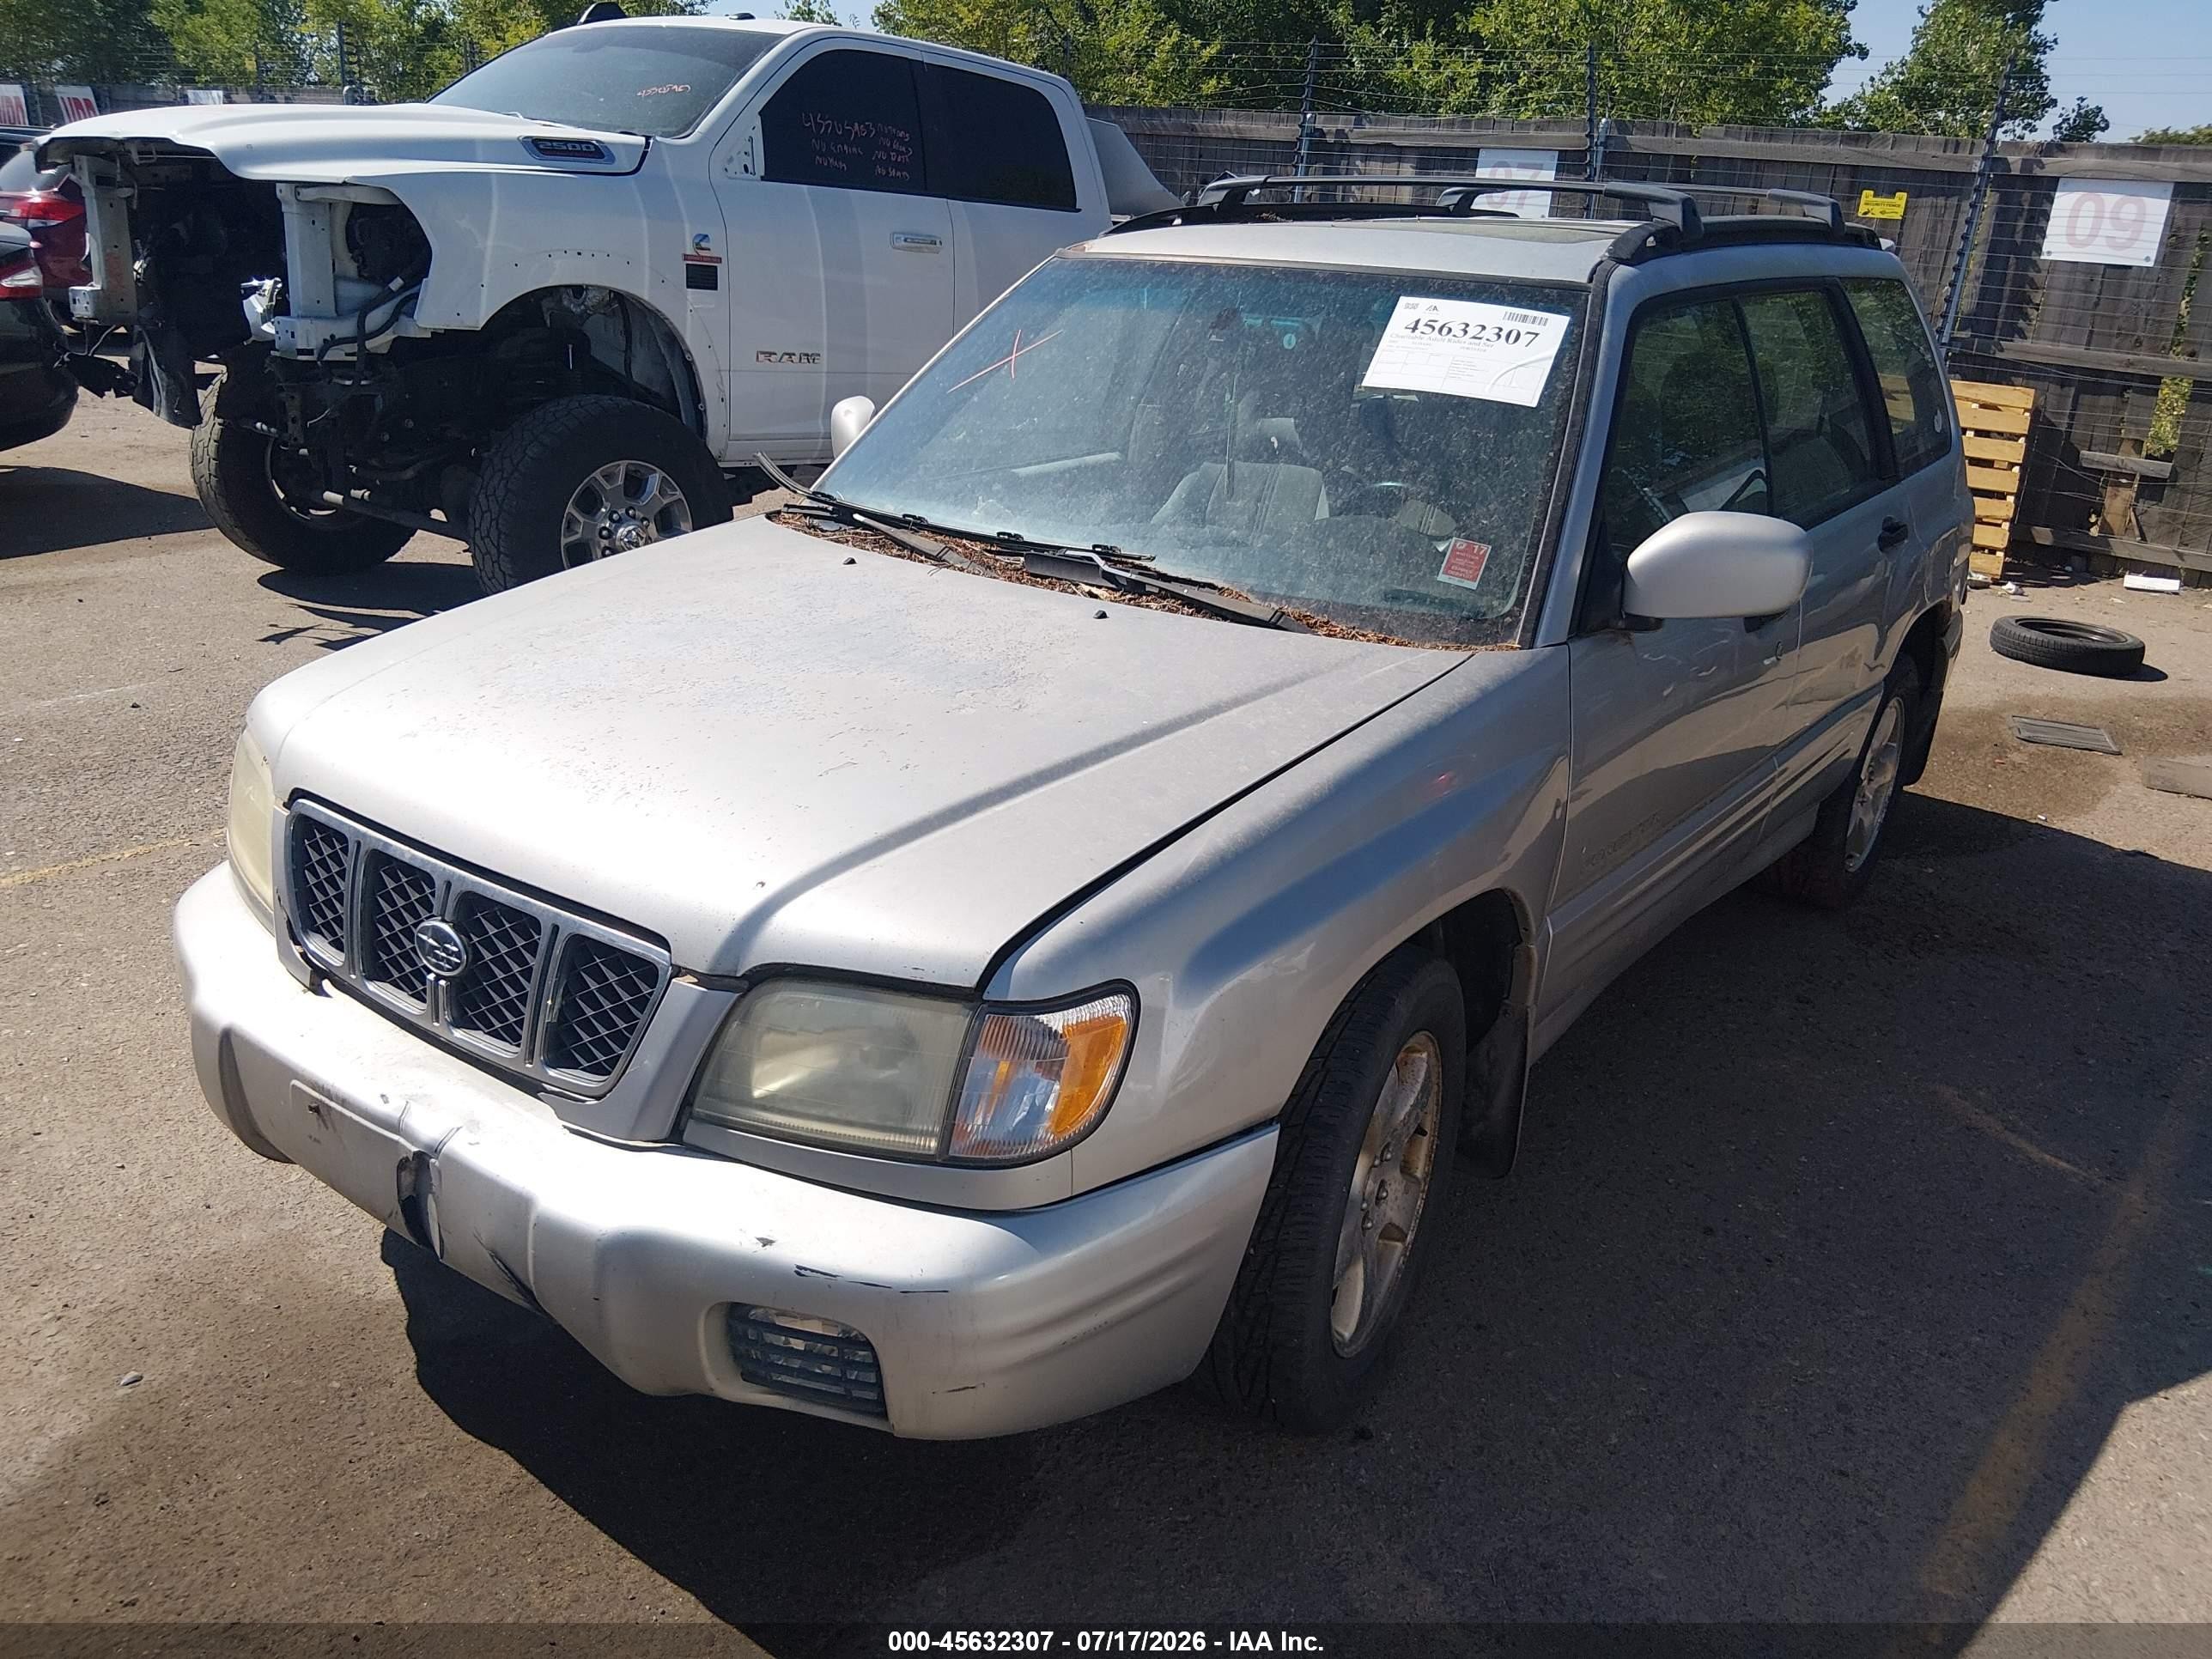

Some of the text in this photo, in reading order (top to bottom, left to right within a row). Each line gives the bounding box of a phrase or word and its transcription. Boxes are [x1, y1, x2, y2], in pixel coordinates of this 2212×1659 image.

[538, 141, 596, 152] 2500
[1486, 160, 1544, 210] 07
[2066, 191, 2147, 252] 09
[1404, 318, 1540, 348] 45632307
[756, 350, 821, 364] RAM
[1473, 545, 1488, 555] 17
